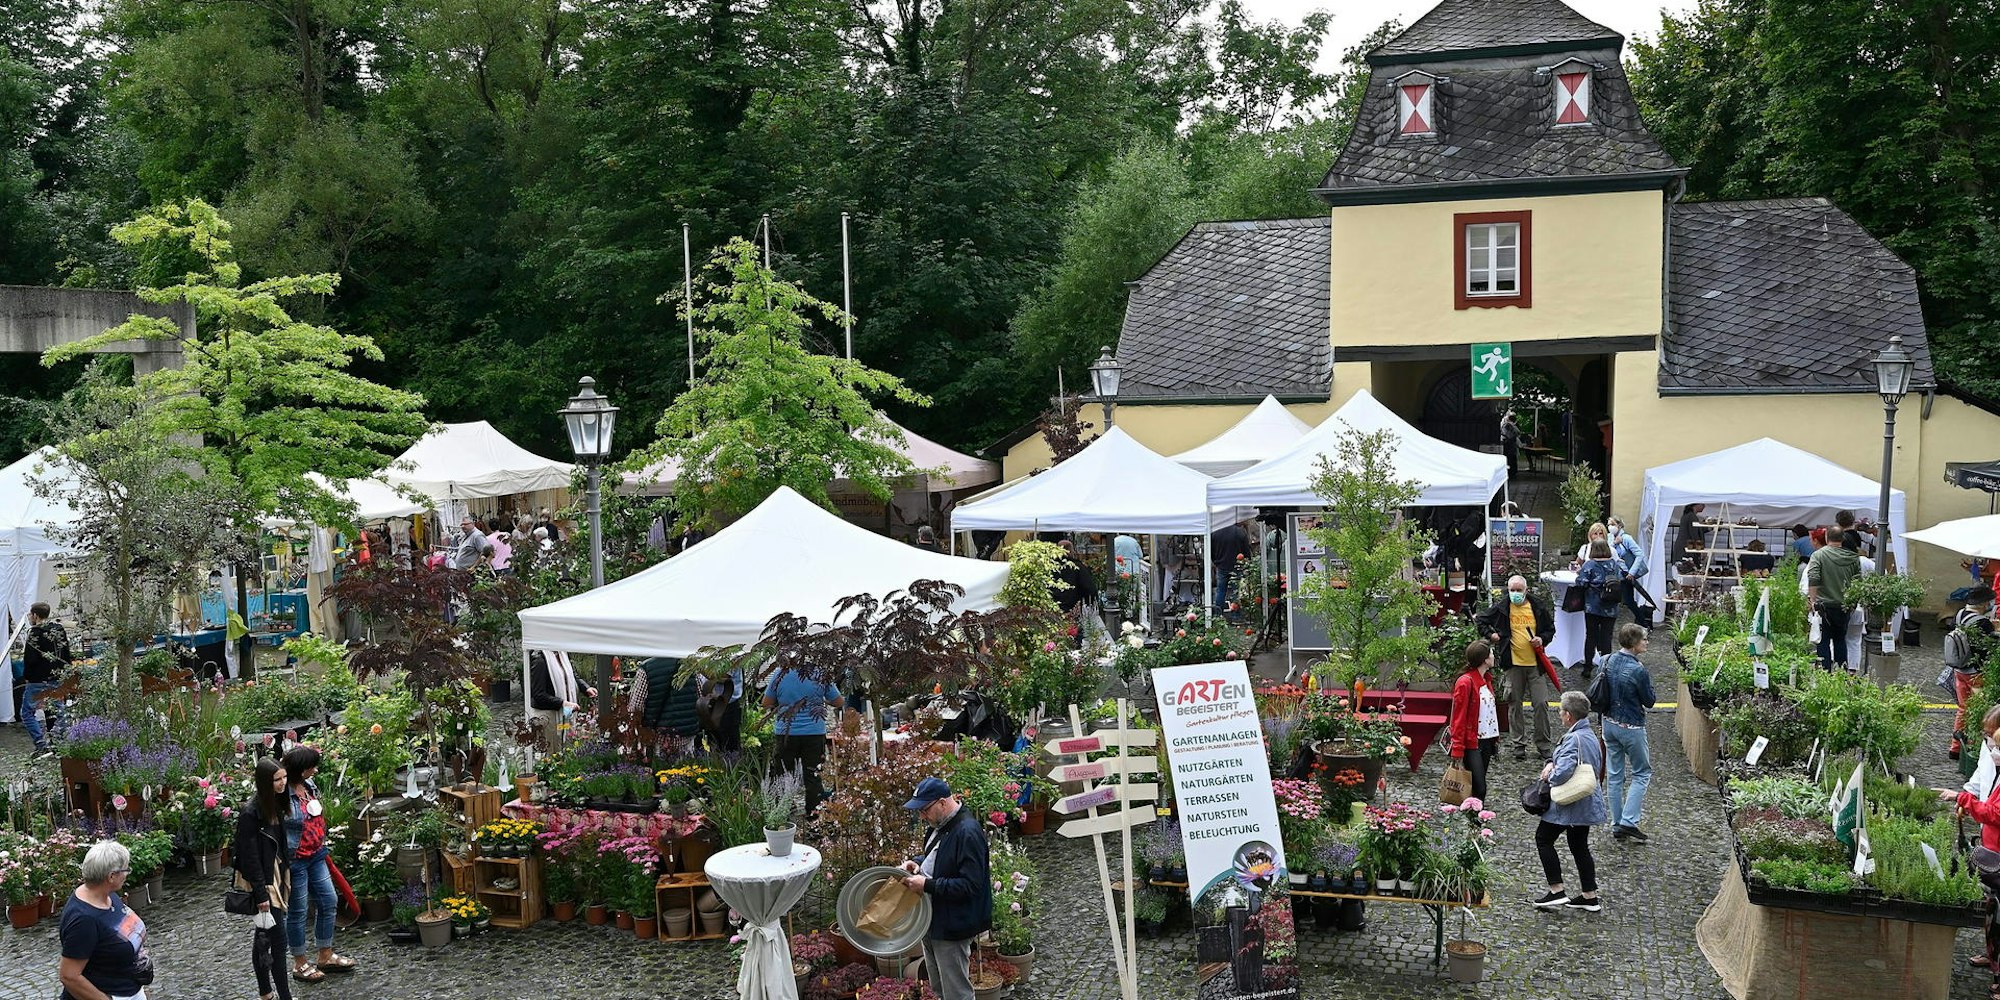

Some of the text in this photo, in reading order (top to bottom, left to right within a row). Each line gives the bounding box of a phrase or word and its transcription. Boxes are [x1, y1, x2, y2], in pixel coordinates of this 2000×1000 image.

[1492, 535, 1540, 543] SCHOSSFEST
[1163, 679, 1246, 706] GARTEN
[1177, 701, 1239, 716] BEGEISTERT
[1186, 709, 1254, 728] Gartenkultur pflegen
[1172, 730, 1258, 747] GARTENANLAGEN
[1174, 745, 1205, 753] GESTALTUNG
[1208, 742, 1231, 750] PLANUNG
[1178, 758, 1243, 773] NUTZGÄRTEN
[1181, 773, 1254, 790] NATURGÄRTEN
[1184, 792, 1239, 806] TERRASSEN
[1187, 808, 1248, 823] NATURSTEIN
[1189, 823, 1260, 840] BELEUCHTUNG
